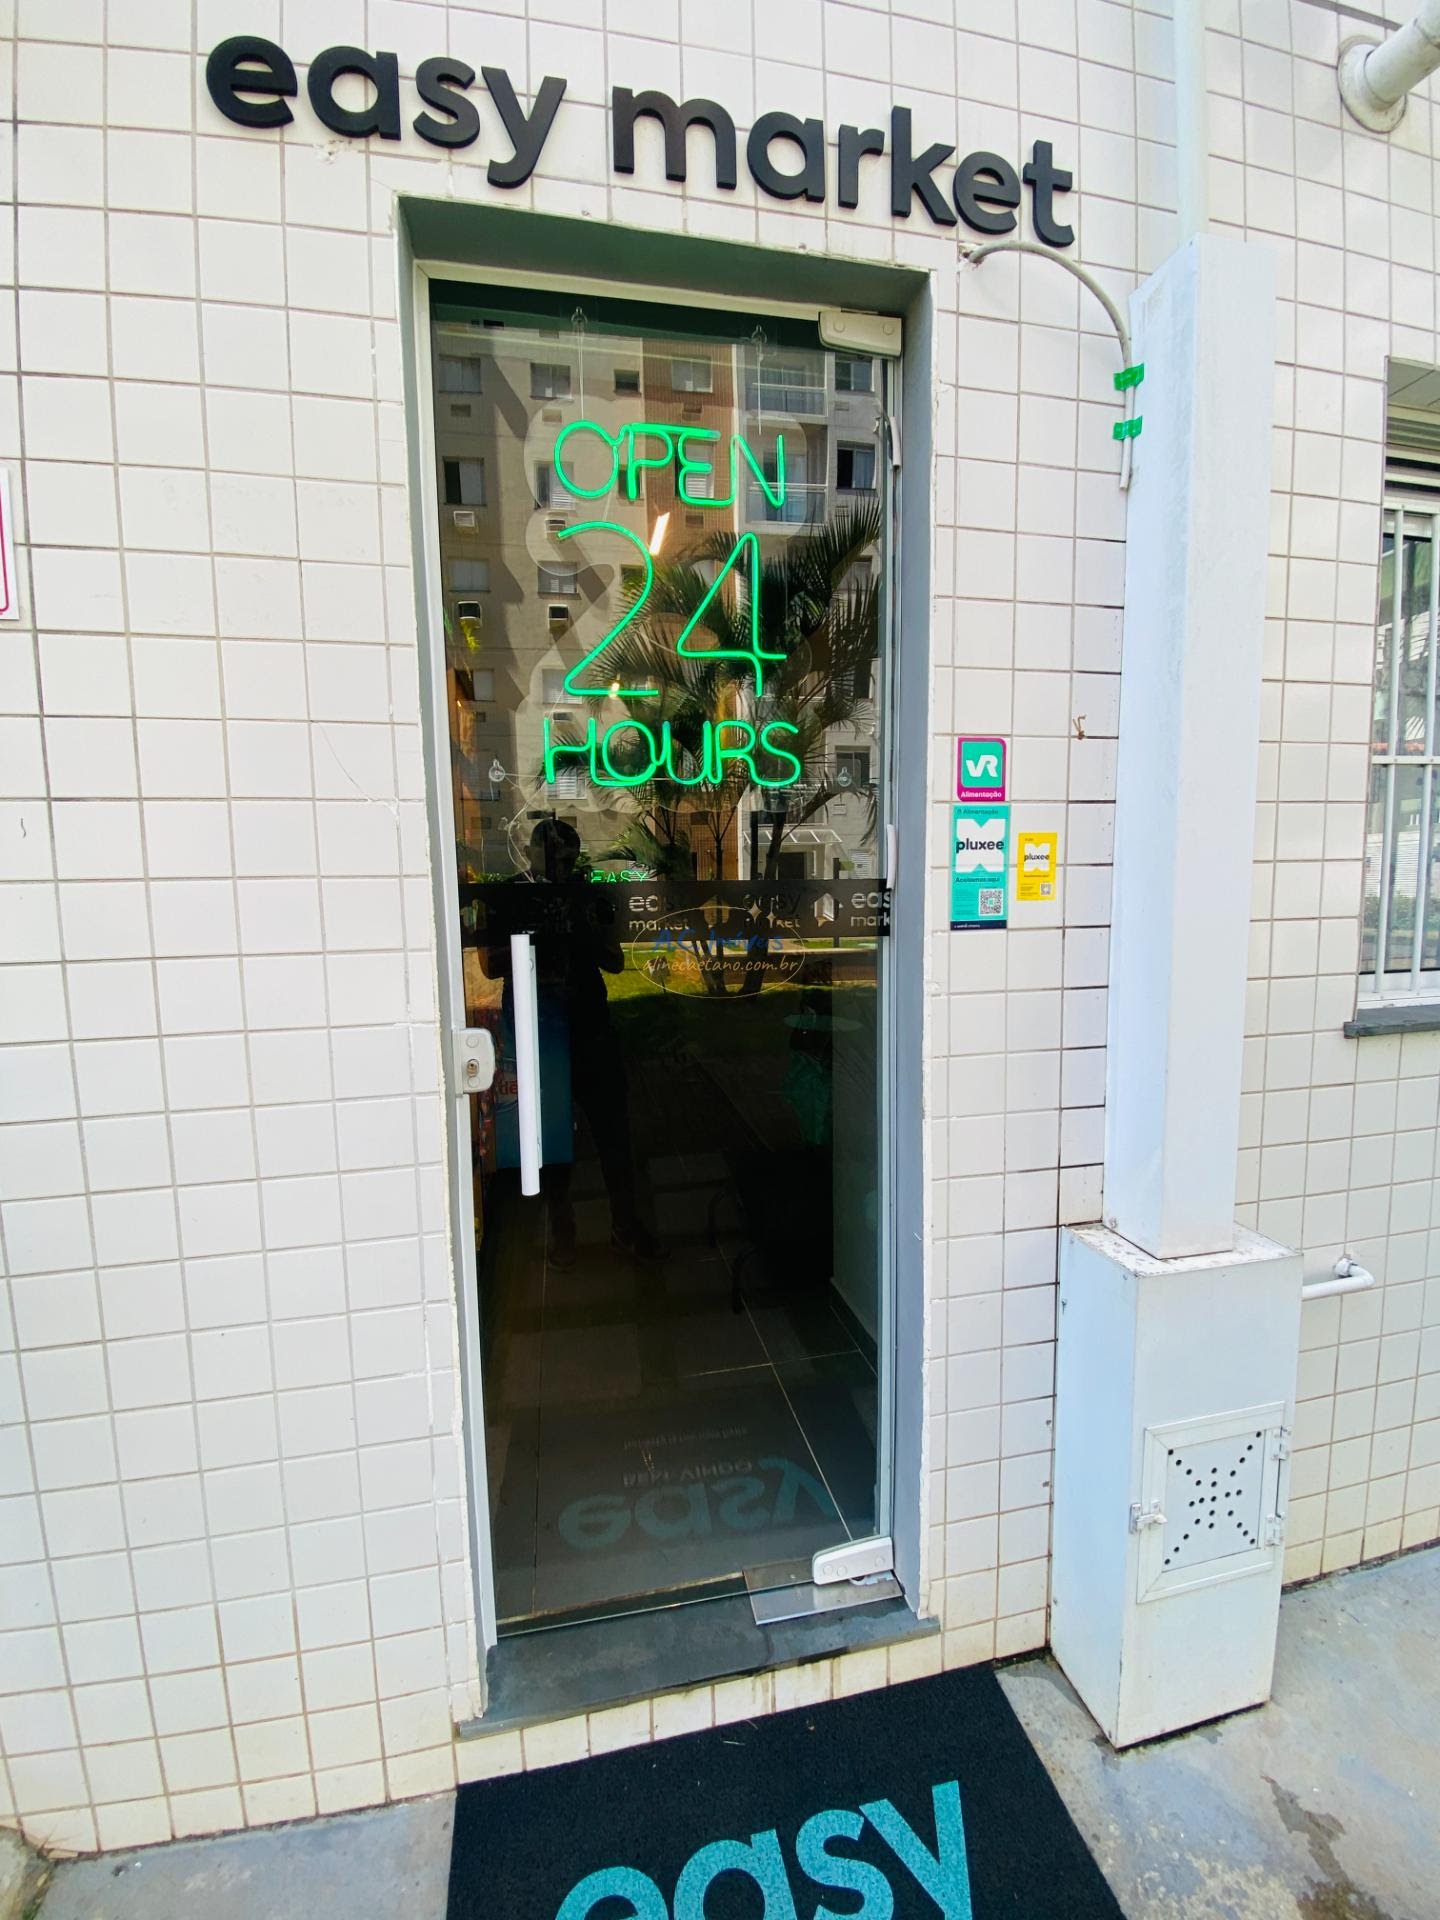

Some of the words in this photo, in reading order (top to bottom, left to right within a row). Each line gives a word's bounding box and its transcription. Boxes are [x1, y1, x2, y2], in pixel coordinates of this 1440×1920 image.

[205, 35, 567, 189] easy
[612, 86, 1075, 248] market
[554, 420, 788, 508] OPEN
[557, 521, 788, 697] 24
[543, 717, 801, 787] HOURS
[956, 838, 1004, 854] pluxee
[1024, 853, 1050, 862] pluxee
